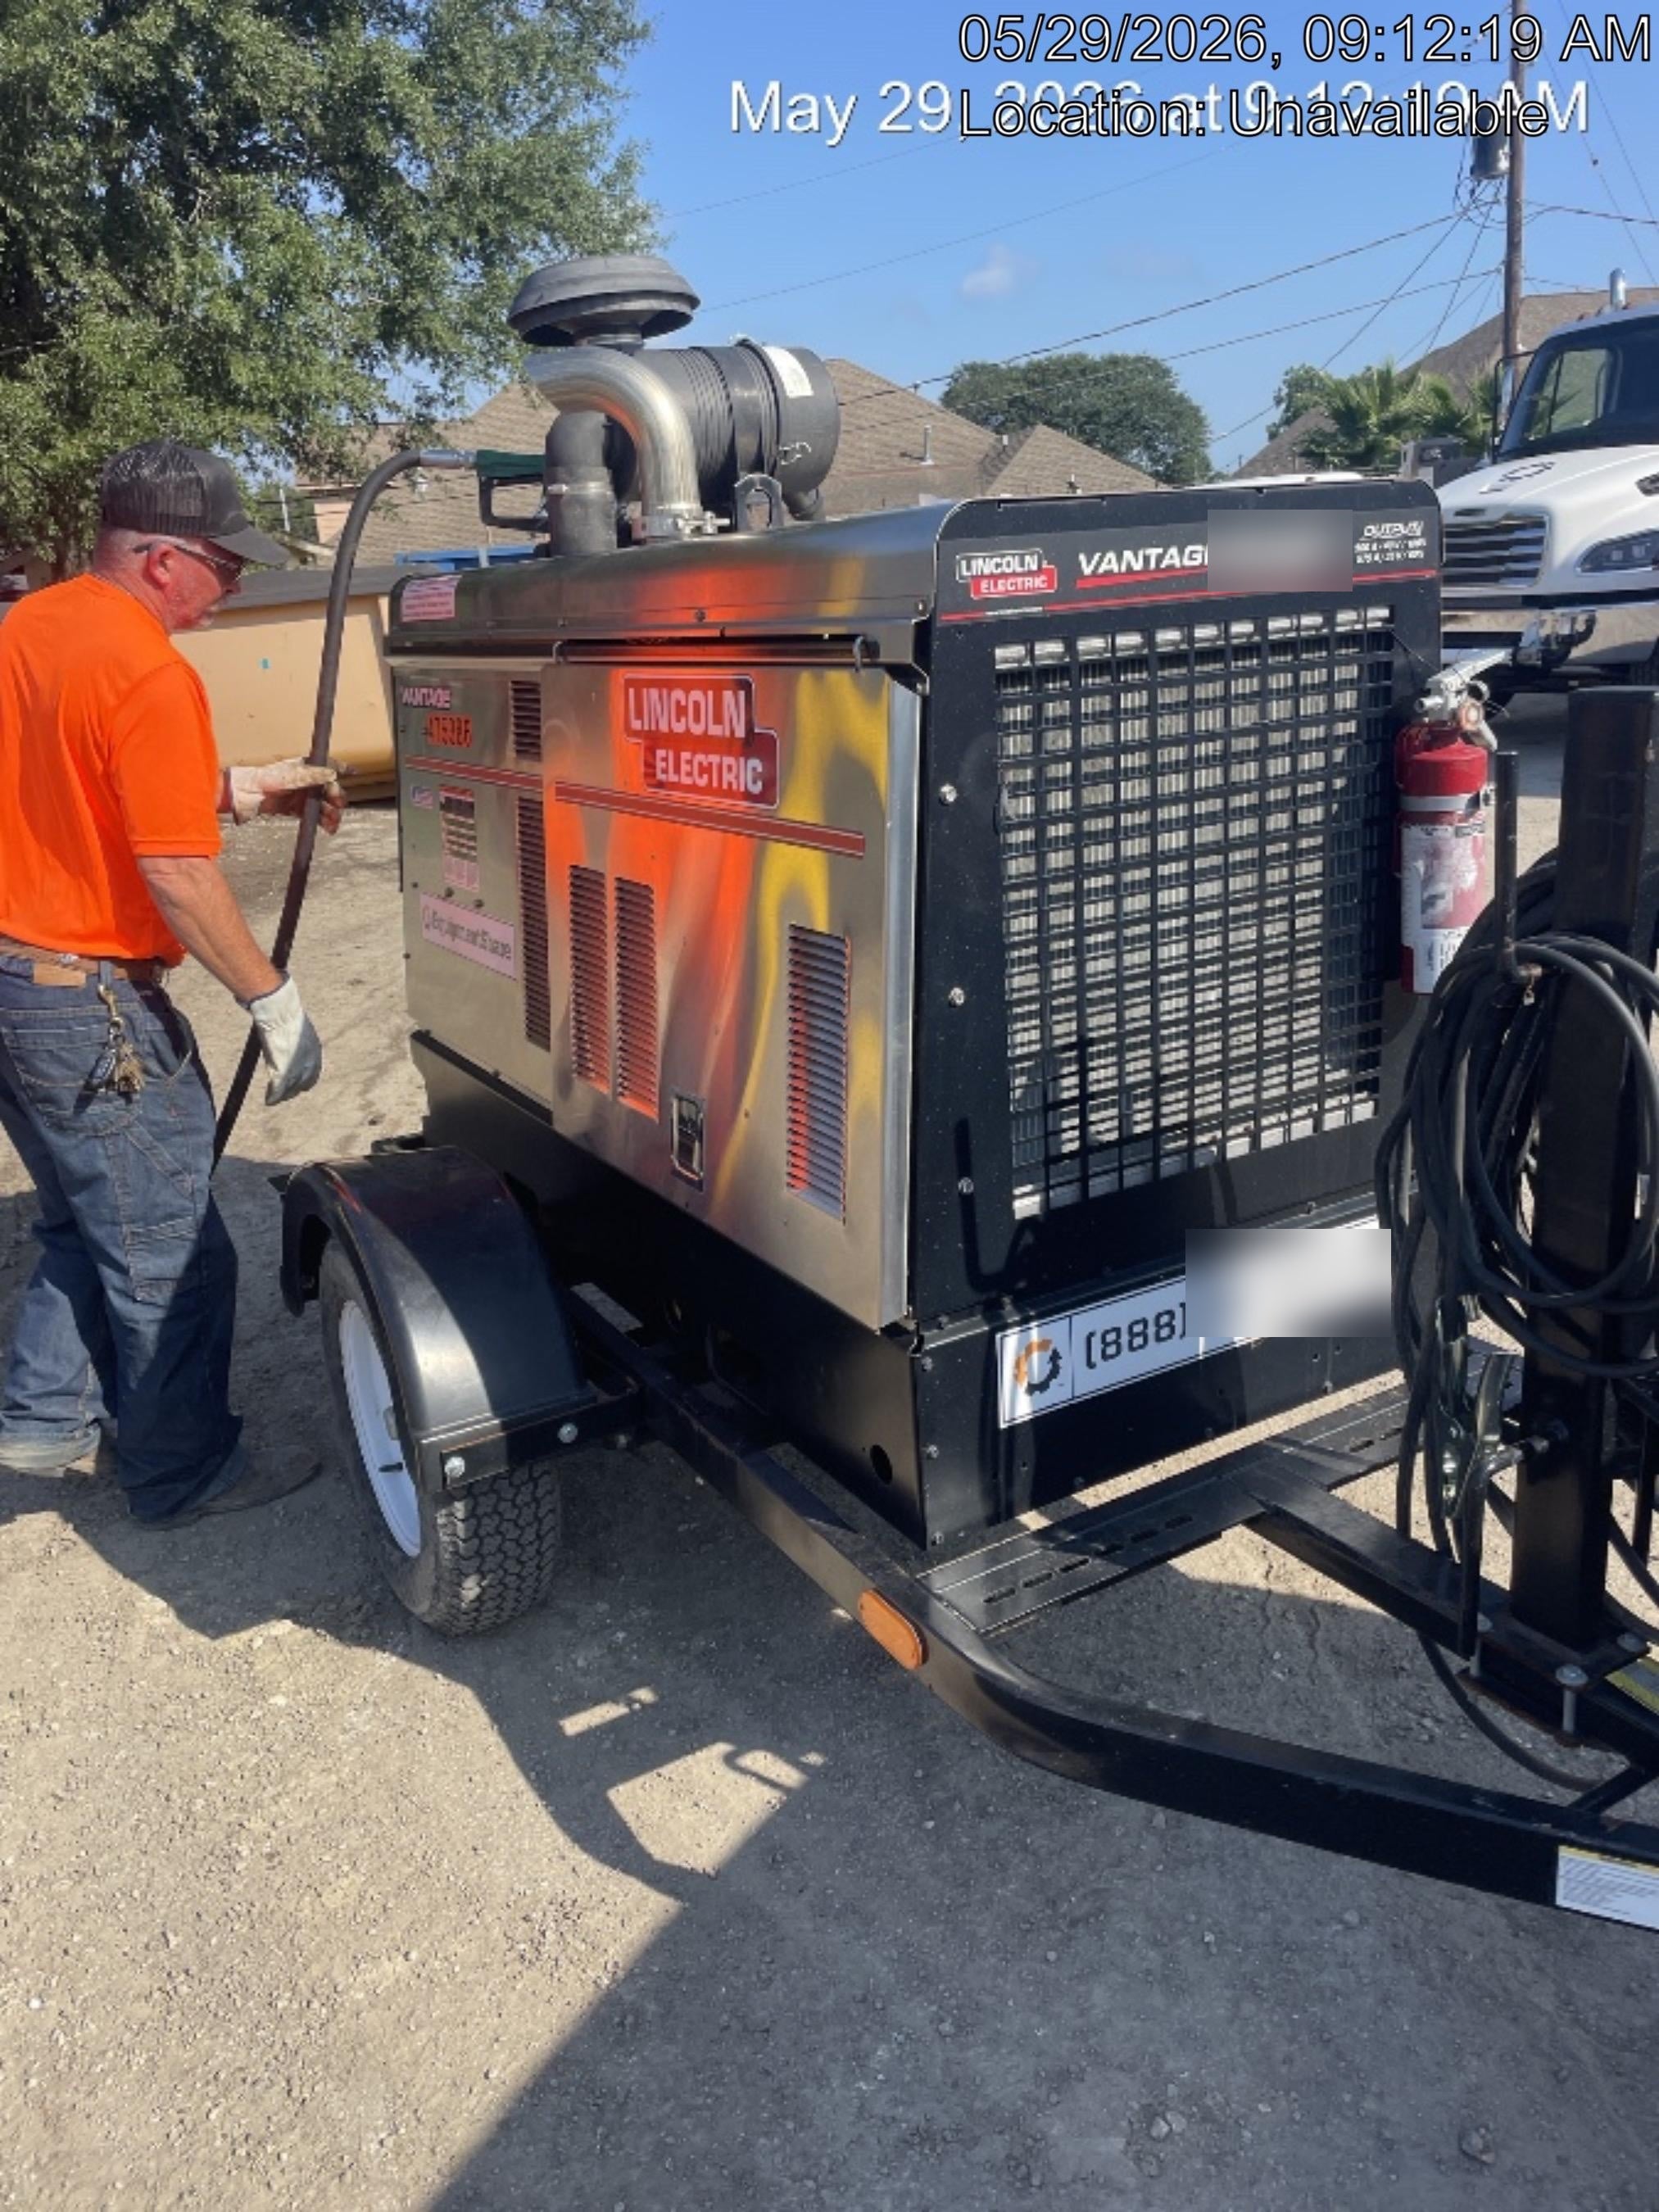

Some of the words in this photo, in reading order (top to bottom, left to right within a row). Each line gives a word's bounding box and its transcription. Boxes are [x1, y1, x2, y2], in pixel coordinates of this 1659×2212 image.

[960, 554, 1038, 577] LINCOLN
[1078, 544, 1208, 576] VANTAG
[980, 575, 1049, 593] ELECTRIC
[628, 687, 746, 738] LINCOLN
[655, 748, 764, 794] ELECTRIC
[1086, 1302, 1186, 1370] (888)
